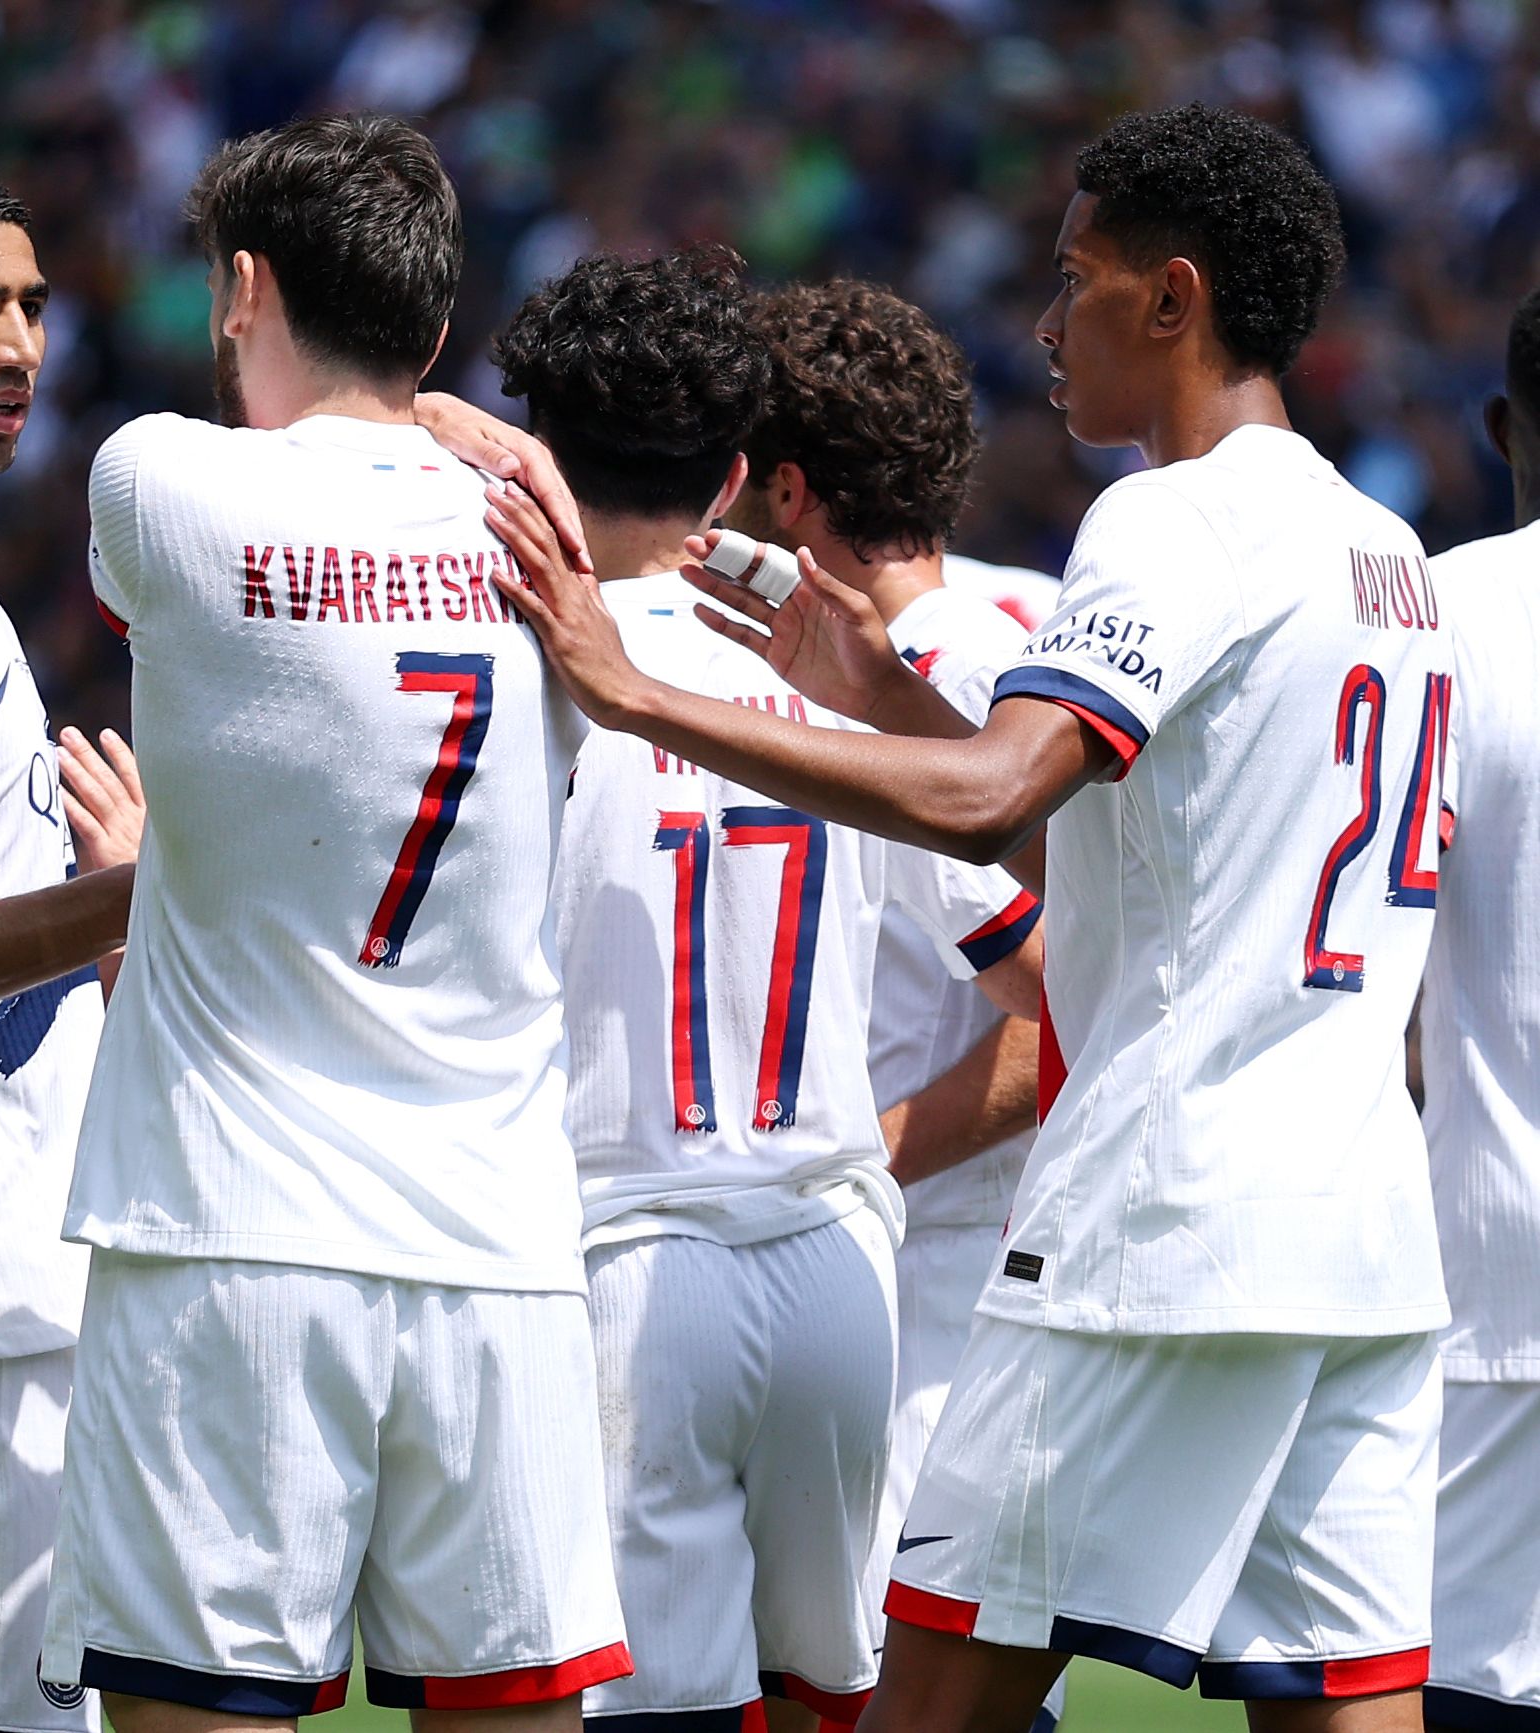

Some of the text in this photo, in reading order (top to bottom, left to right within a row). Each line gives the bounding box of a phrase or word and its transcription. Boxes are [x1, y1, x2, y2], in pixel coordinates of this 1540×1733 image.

[243, 544, 542, 624] KVARATSKH
[1349, 546, 1439, 631] MAYULU
[356, 650, 497, 970] 7
[649, 804, 829, 1135] 17
